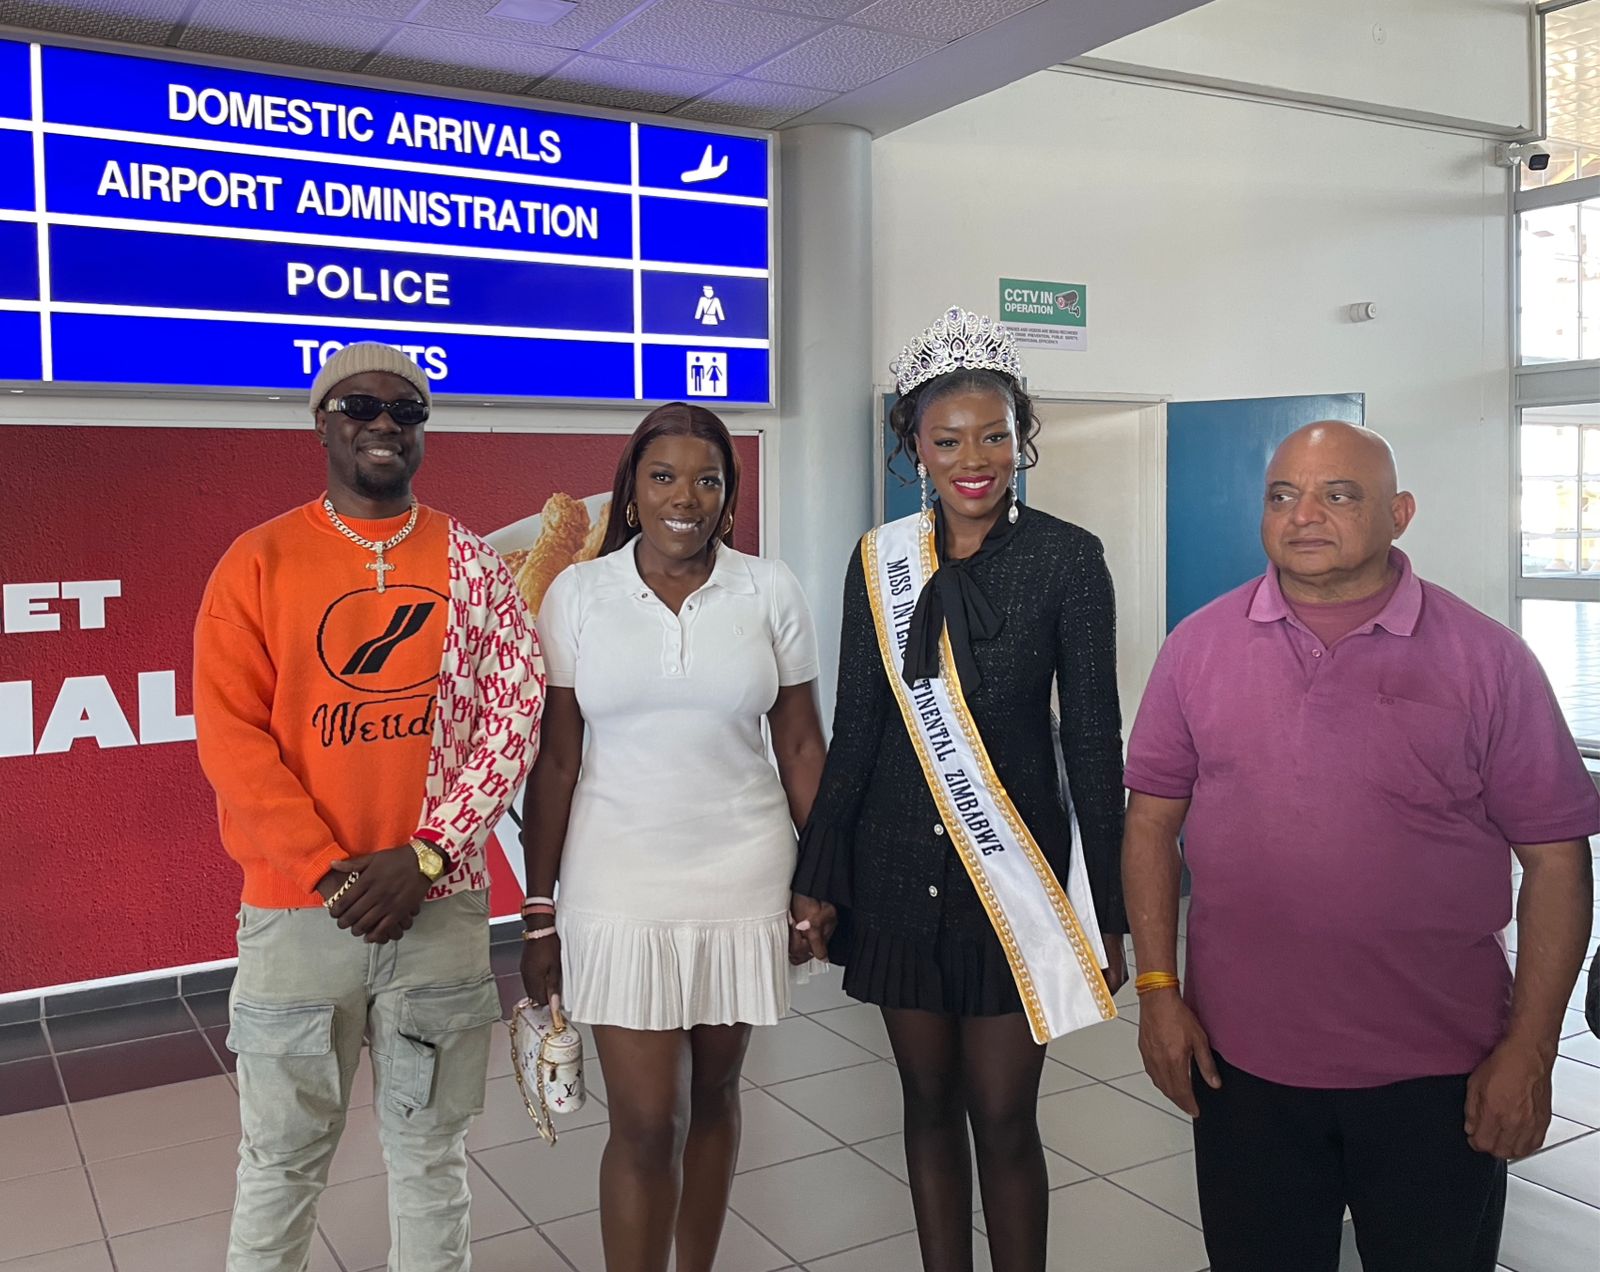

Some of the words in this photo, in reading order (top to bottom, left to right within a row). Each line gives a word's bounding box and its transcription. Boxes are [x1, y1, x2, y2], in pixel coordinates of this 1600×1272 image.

[168, 83, 374, 142] DOMESTIC
[387, 111, 562, 164] ARRIVALS
[97, 160, 283, 211] AIRPORT
[296, 180, 600, 240] ADMINISTRATION
[287, 262, 450, 306] POLICE
[1004, 288, 1038, 304] CCTV
[1041, 291, 1053, 304] IN
[1004, 302, 1054, 315] OPERATION
[293, 339, 449, 381] TOTS
[0, 579, 122, 634] ET
[886, 556, 912, 596] MISS
[944, 768, 1005, 857] ZIMBABWE
